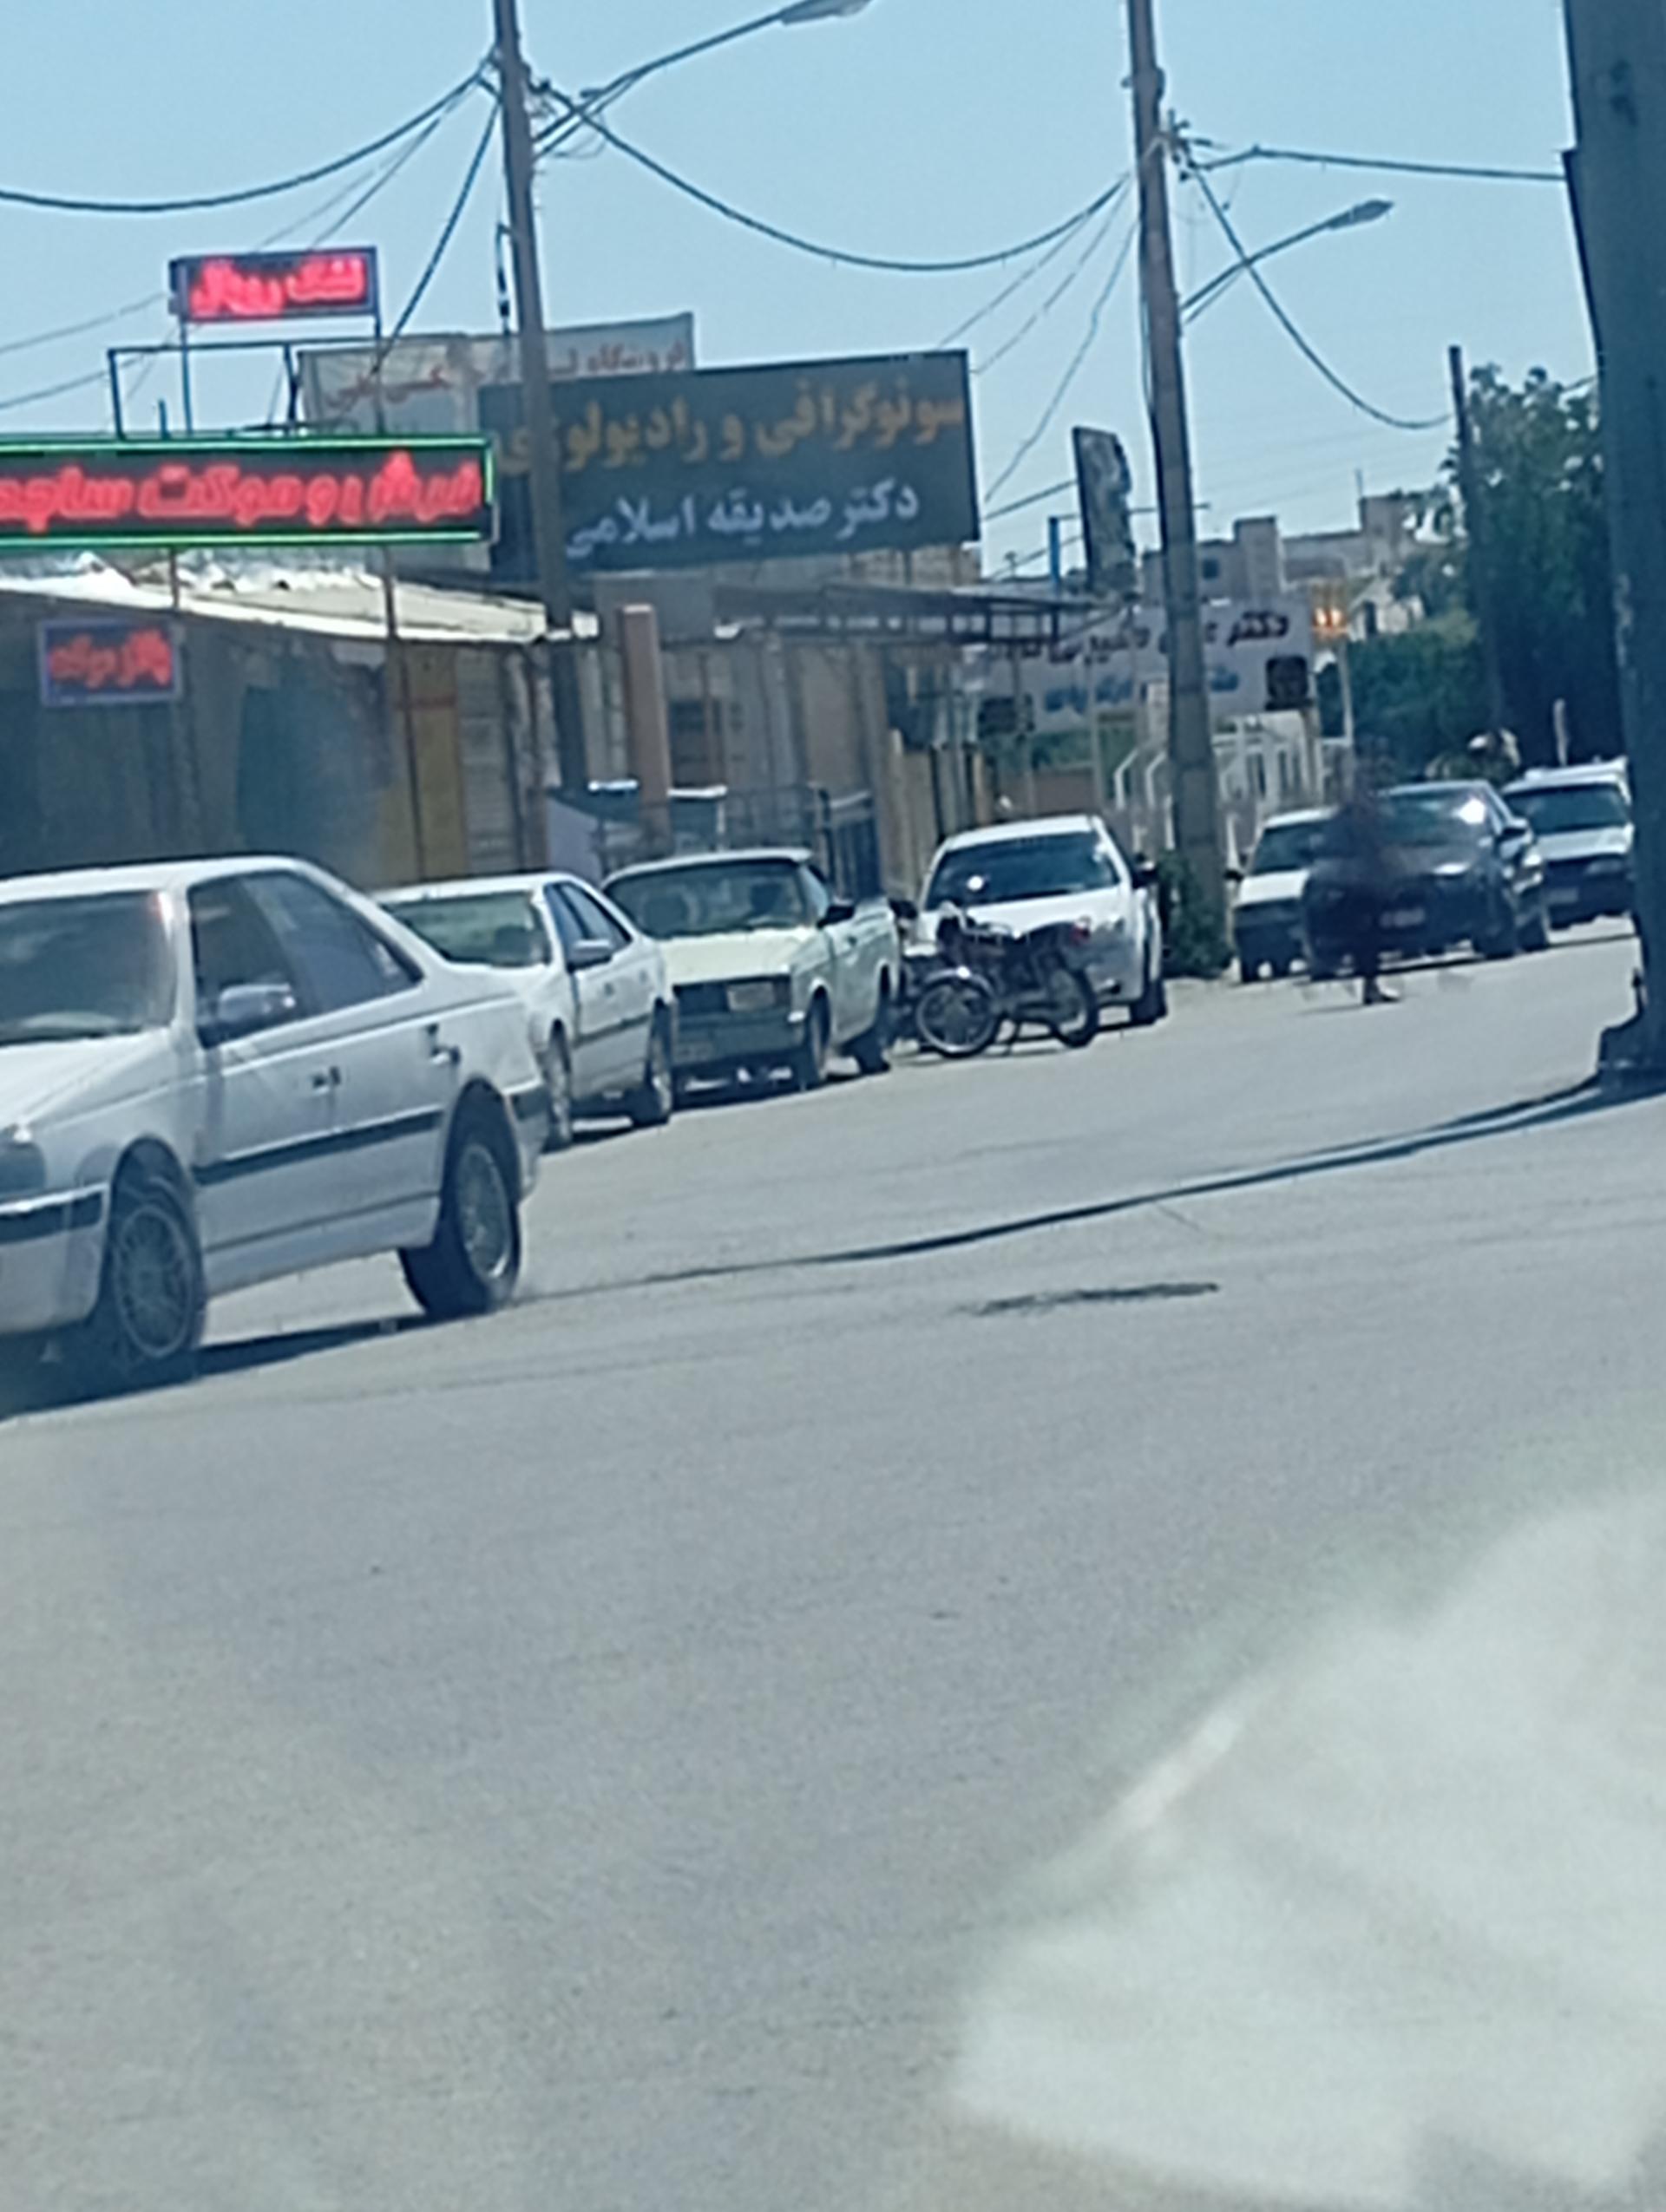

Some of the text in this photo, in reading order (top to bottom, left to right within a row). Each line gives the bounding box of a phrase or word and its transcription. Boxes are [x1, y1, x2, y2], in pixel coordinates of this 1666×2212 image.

[498, 376, 966, 477] سونوگرافی و رادیولوی
[137, 463, 303, 526] موکت
[564, 475, 921, 563] دکتر صدیقه اسلامی
